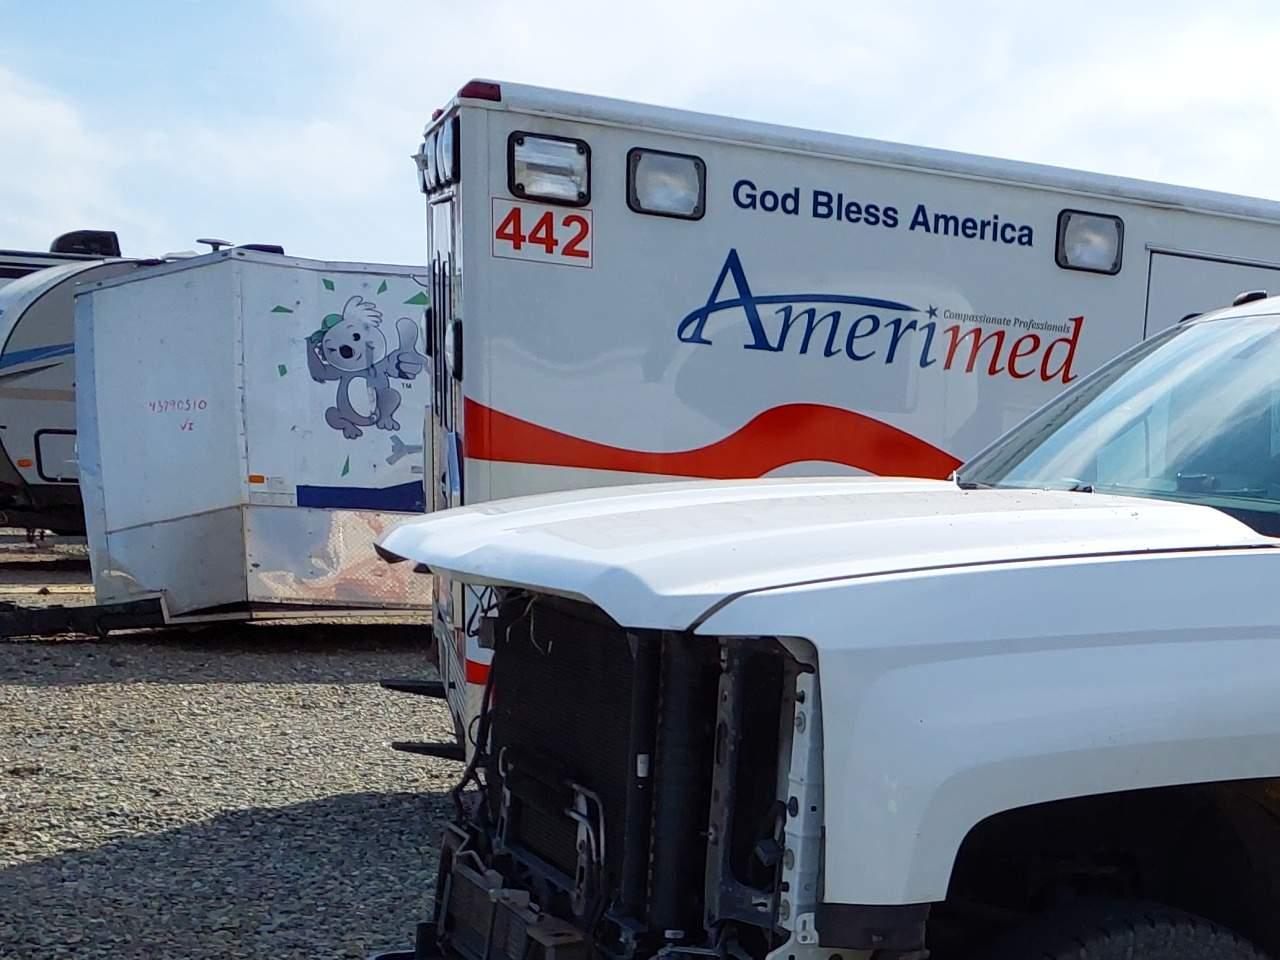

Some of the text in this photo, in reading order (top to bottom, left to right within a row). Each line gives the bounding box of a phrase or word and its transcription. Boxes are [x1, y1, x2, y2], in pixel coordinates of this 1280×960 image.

[496, 207, 590, 258] 442
[732, 179, 1034, 247] God Bless America
[677, 248, 1085, 385] Amerimed
[943, 309, 1072, 334] Compassionate Professionals
